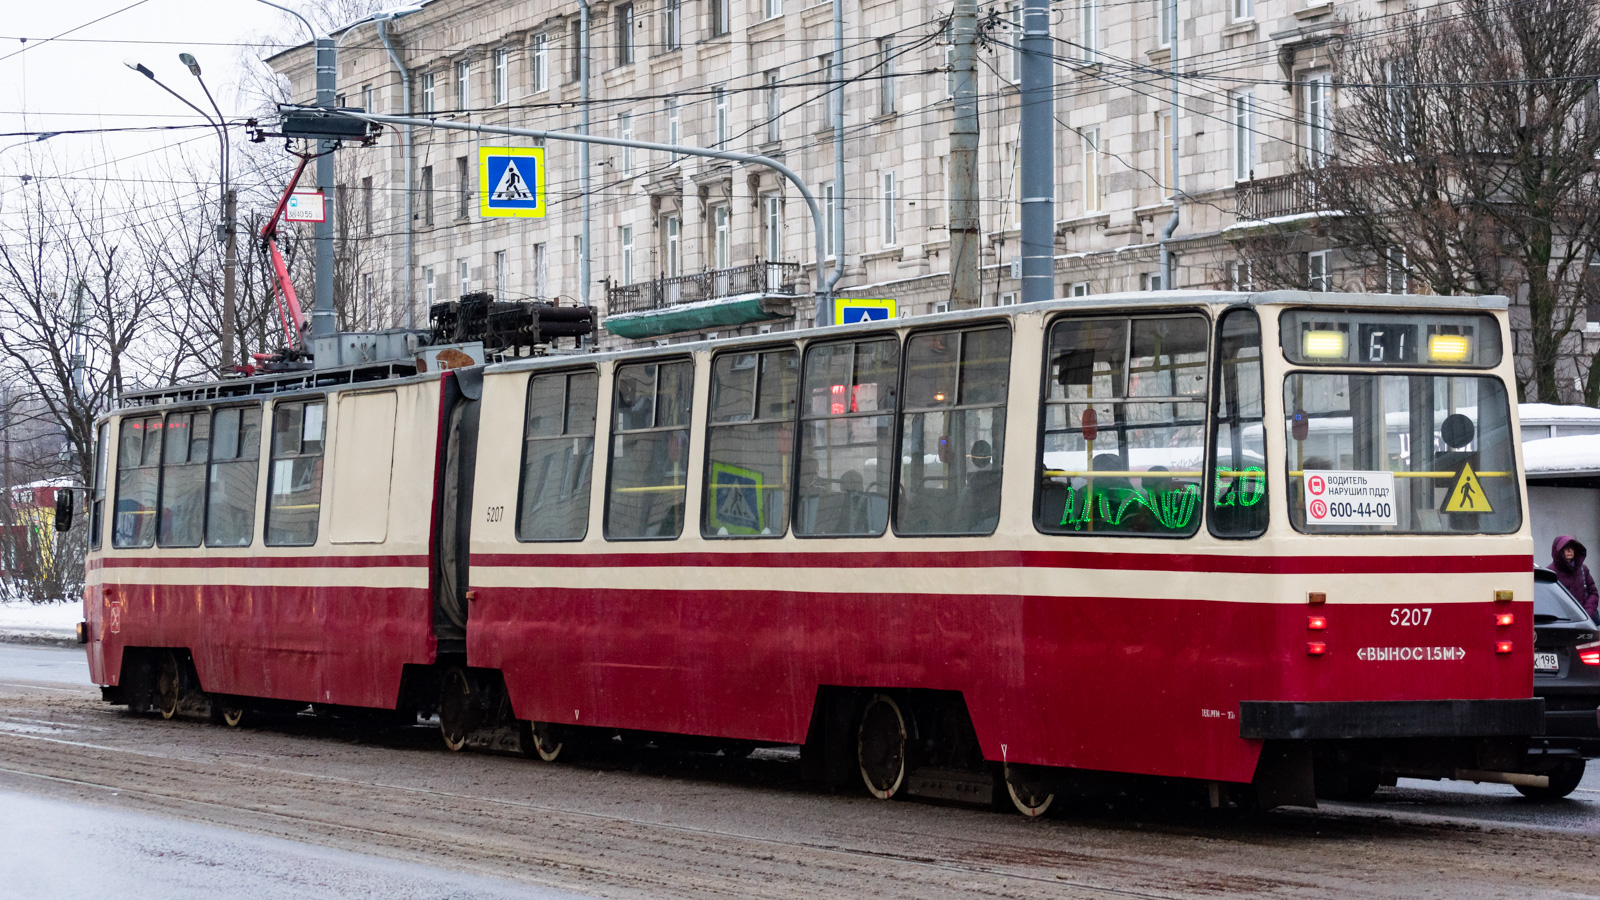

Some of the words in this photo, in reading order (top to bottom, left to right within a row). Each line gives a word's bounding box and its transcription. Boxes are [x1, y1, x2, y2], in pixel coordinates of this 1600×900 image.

[1369, 331, 1405, 362] 61
[1328, 476, 1368, 486] ВОДИТЕЛЬ
[1328, 487, 1368, 496] НАРУШИЛ
[1369, 488, 1390, 497] ПДД?
[487, 506, 504, 522] 5207
[1330, 502, 1391, 518] 600-44-00
[1389, 608, 1432, 626] 5207
[1367, 647, 1423, 661] ВЫНОС
[1541, 655, 1556, 665] 198
